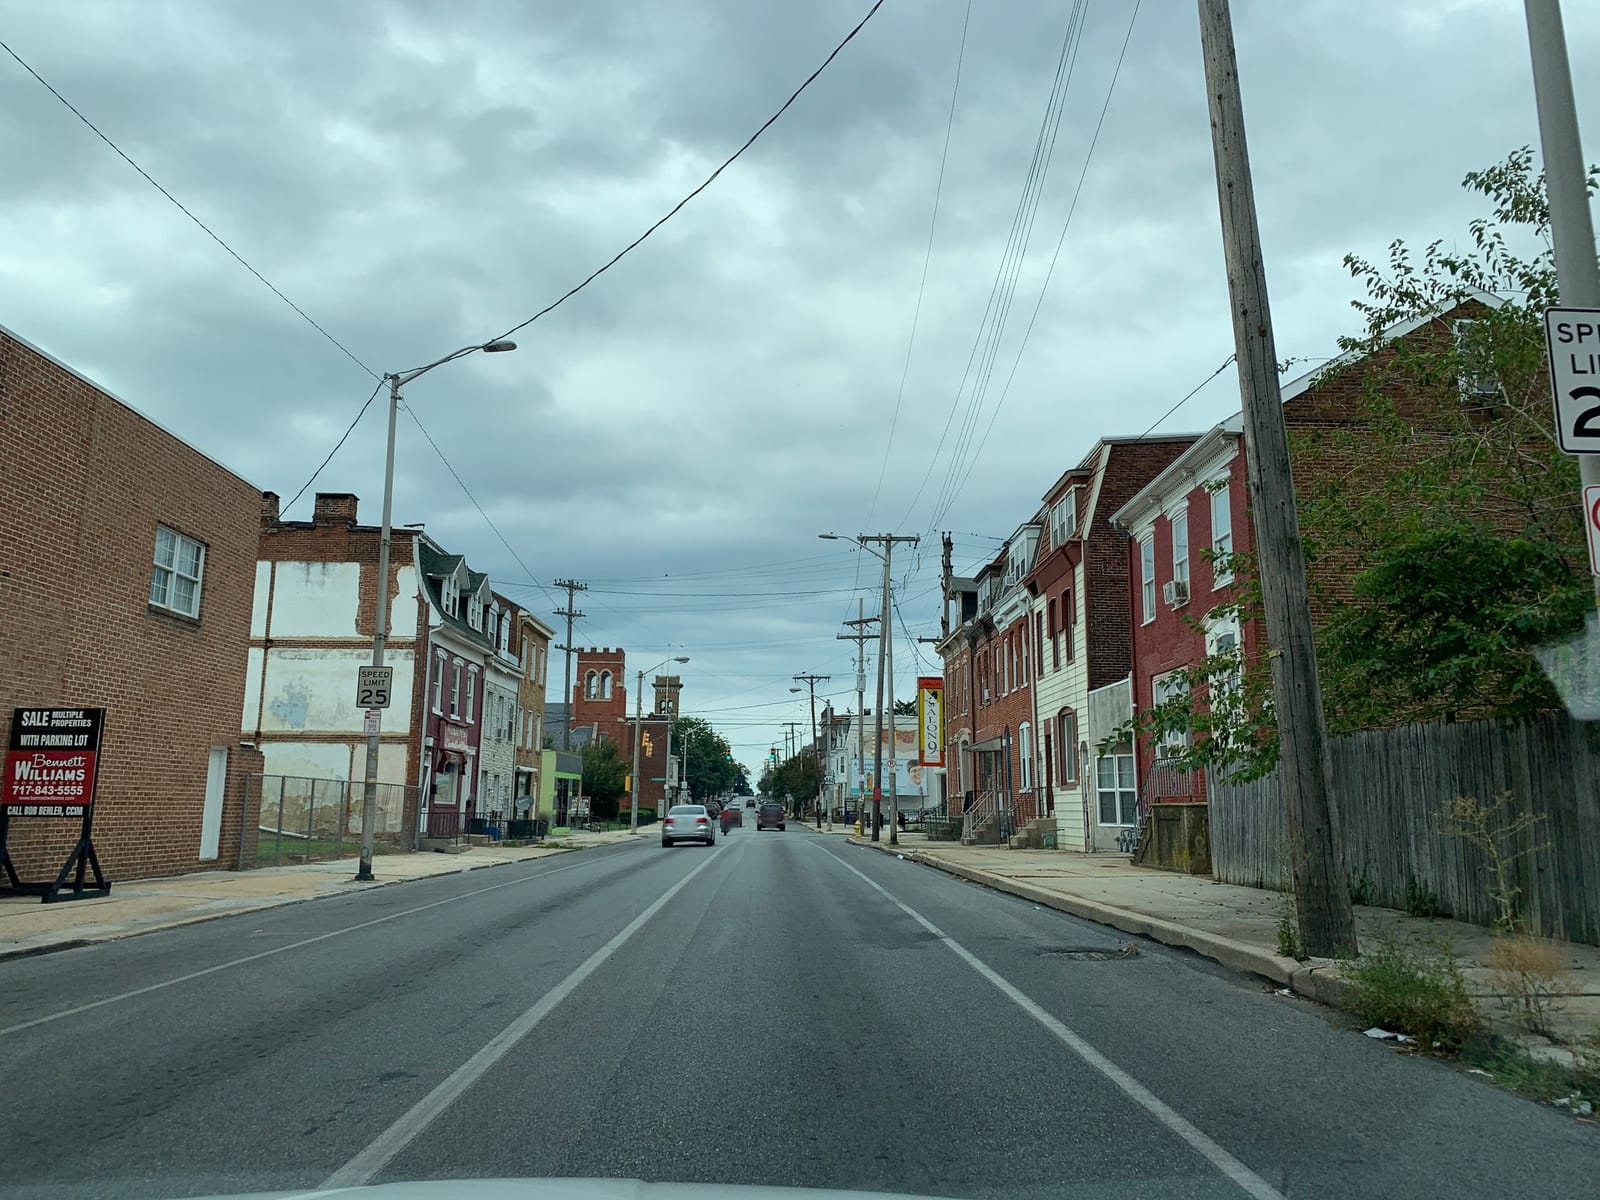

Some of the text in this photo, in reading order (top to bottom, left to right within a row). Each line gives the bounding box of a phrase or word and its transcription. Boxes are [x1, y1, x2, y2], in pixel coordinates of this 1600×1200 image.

[1557, 323, 1600, 343] SP
[1571, 353, 1600, 374] LI
[361, 670, 389, 678] SPEED
[360, 689, 387, 704] 25
[21, 711, 50, 726] SALE
[51, 711, 84, 719] MULTIPLE
[50, 719, 92, 727] PROPERTIES
[20, 734, 89, 746] WITH PARKING LOT
[32, 753, 87, 768] Bennett
[15, 760, 85, 781] WILLIAMS
[12, 785, 84, 795] 717-843-5555
[7, 806, 23, 815] CALL
[23, 806, 38, 815] BOB
